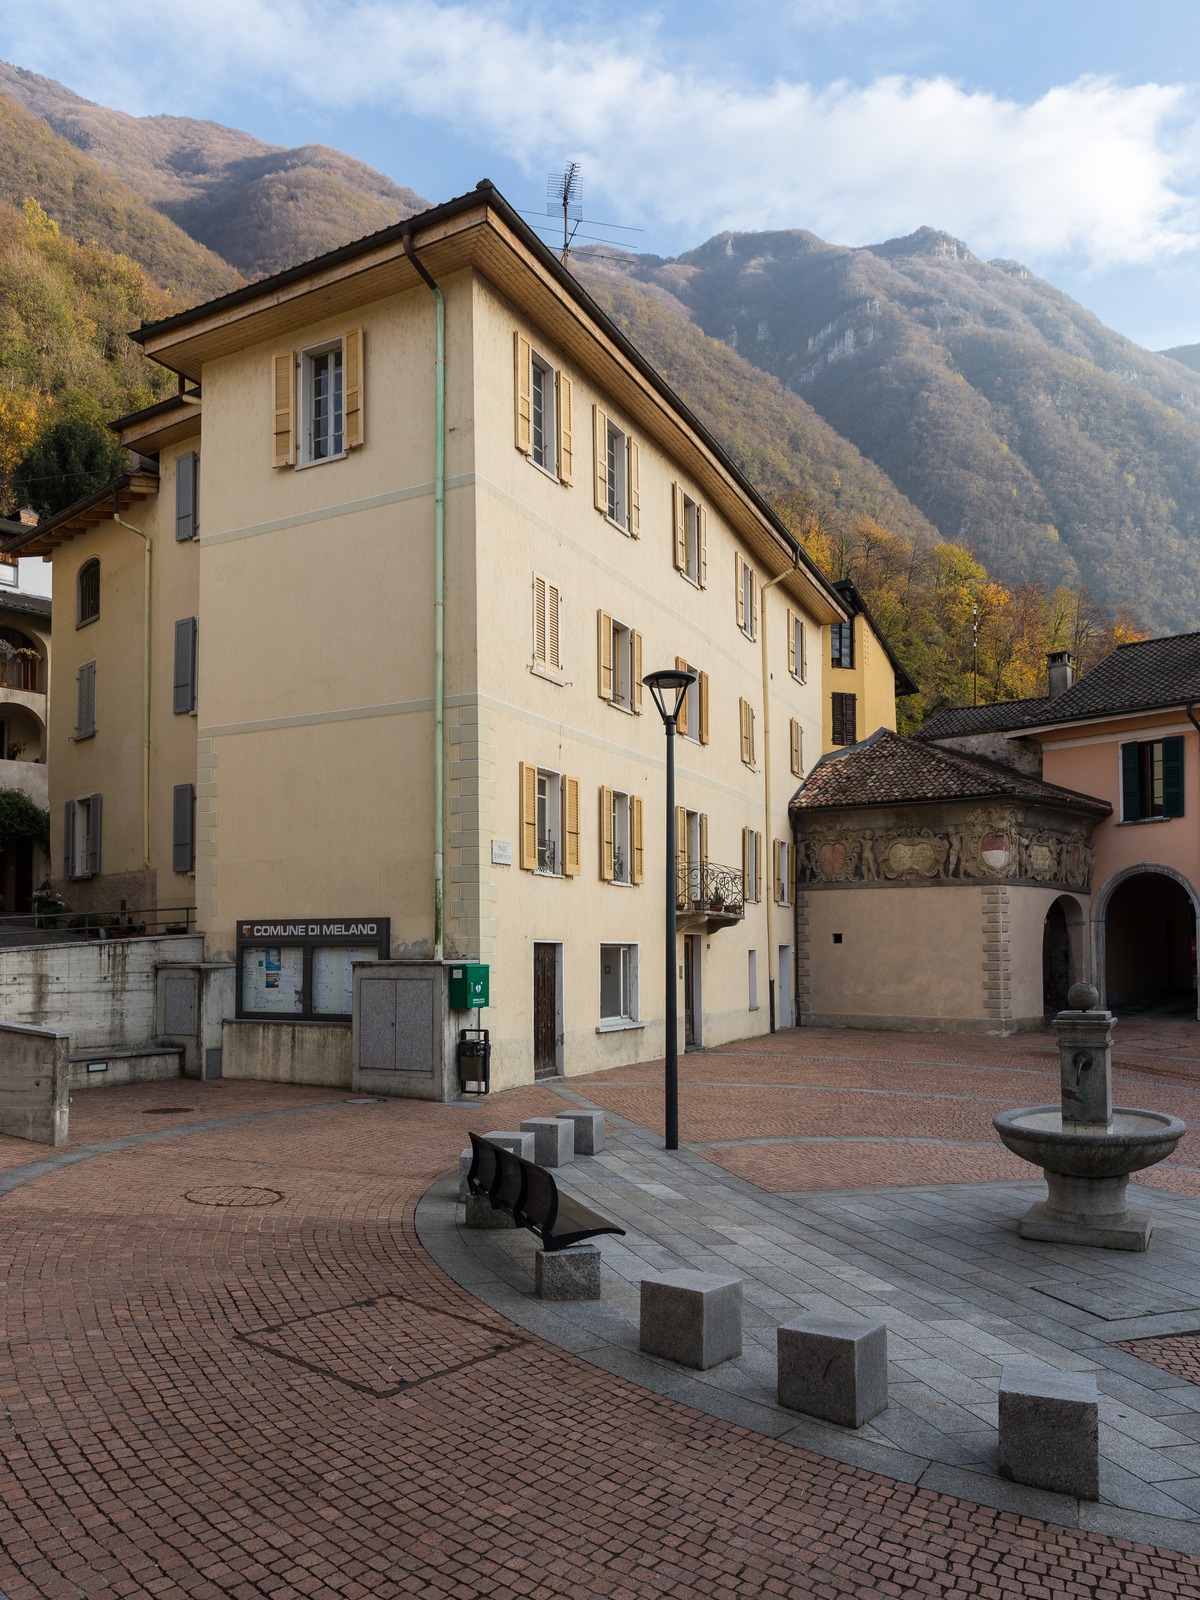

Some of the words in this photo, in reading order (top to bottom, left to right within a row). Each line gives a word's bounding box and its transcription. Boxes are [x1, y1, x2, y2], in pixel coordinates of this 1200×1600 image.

[254, 925, 306, 936] COMUNE
[308, 925, 320, 935] DI
[323, 924, 377, 935] MELANO
